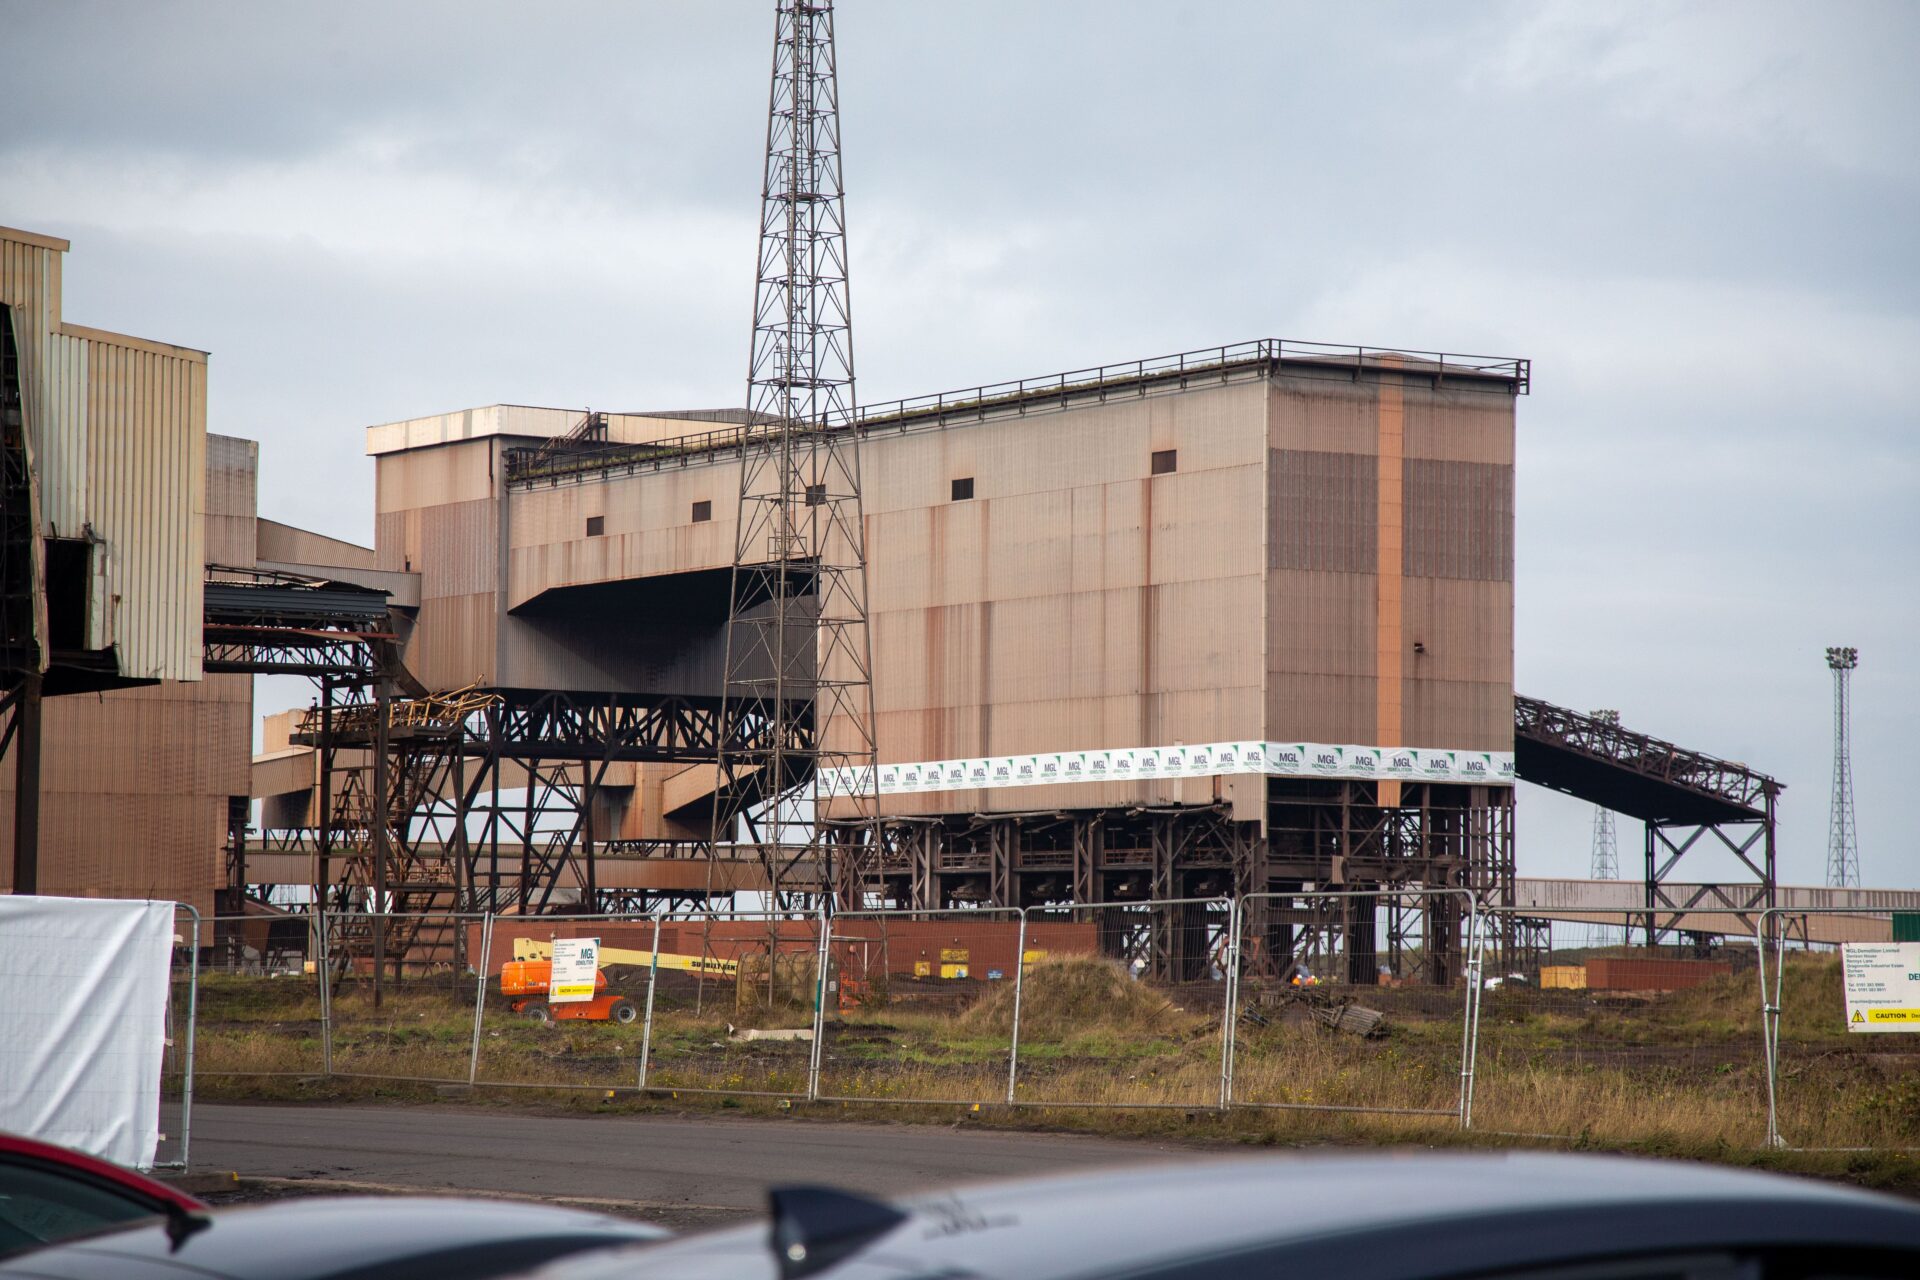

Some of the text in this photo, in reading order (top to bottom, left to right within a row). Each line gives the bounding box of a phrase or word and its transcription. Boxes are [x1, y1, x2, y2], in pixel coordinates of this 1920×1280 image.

[1168, 756, 1181, 765] MGL
[1194, 755, 1208, 764] MGL
[1221, 753, 1234, 762] MGL
[1248, 752, 1261, 761] MGL
[1280, 753, 1298, 762] MGL
[1318, 754, 1336, 764] MGL
[1356, 756, 1374, 766] MGL
[1069, 762, 1080, 770] MGL
[1093, 761, 1106, 769] MGL
[1118, 760, 1130, 768] MGL
[1143, 758, 1156, 766] MGL
[1394, 758, 1412, 767] MGL
[1431, 760, 1449, 769] MGL
[1467, 761, 1486, 770] MGL
[974, 768, 985, 776] MGL
[997, 767, 1008, 775] MGL
[1021, 765, 1032, 773] MGL
[1045, 764, 1056, 772] MGL
[884, 774, 895, 782] MGL
[928, 771, 940, 779] MGL
[951, 769, 962, 778] MGL
[581, 948, 594, 959] MGL
